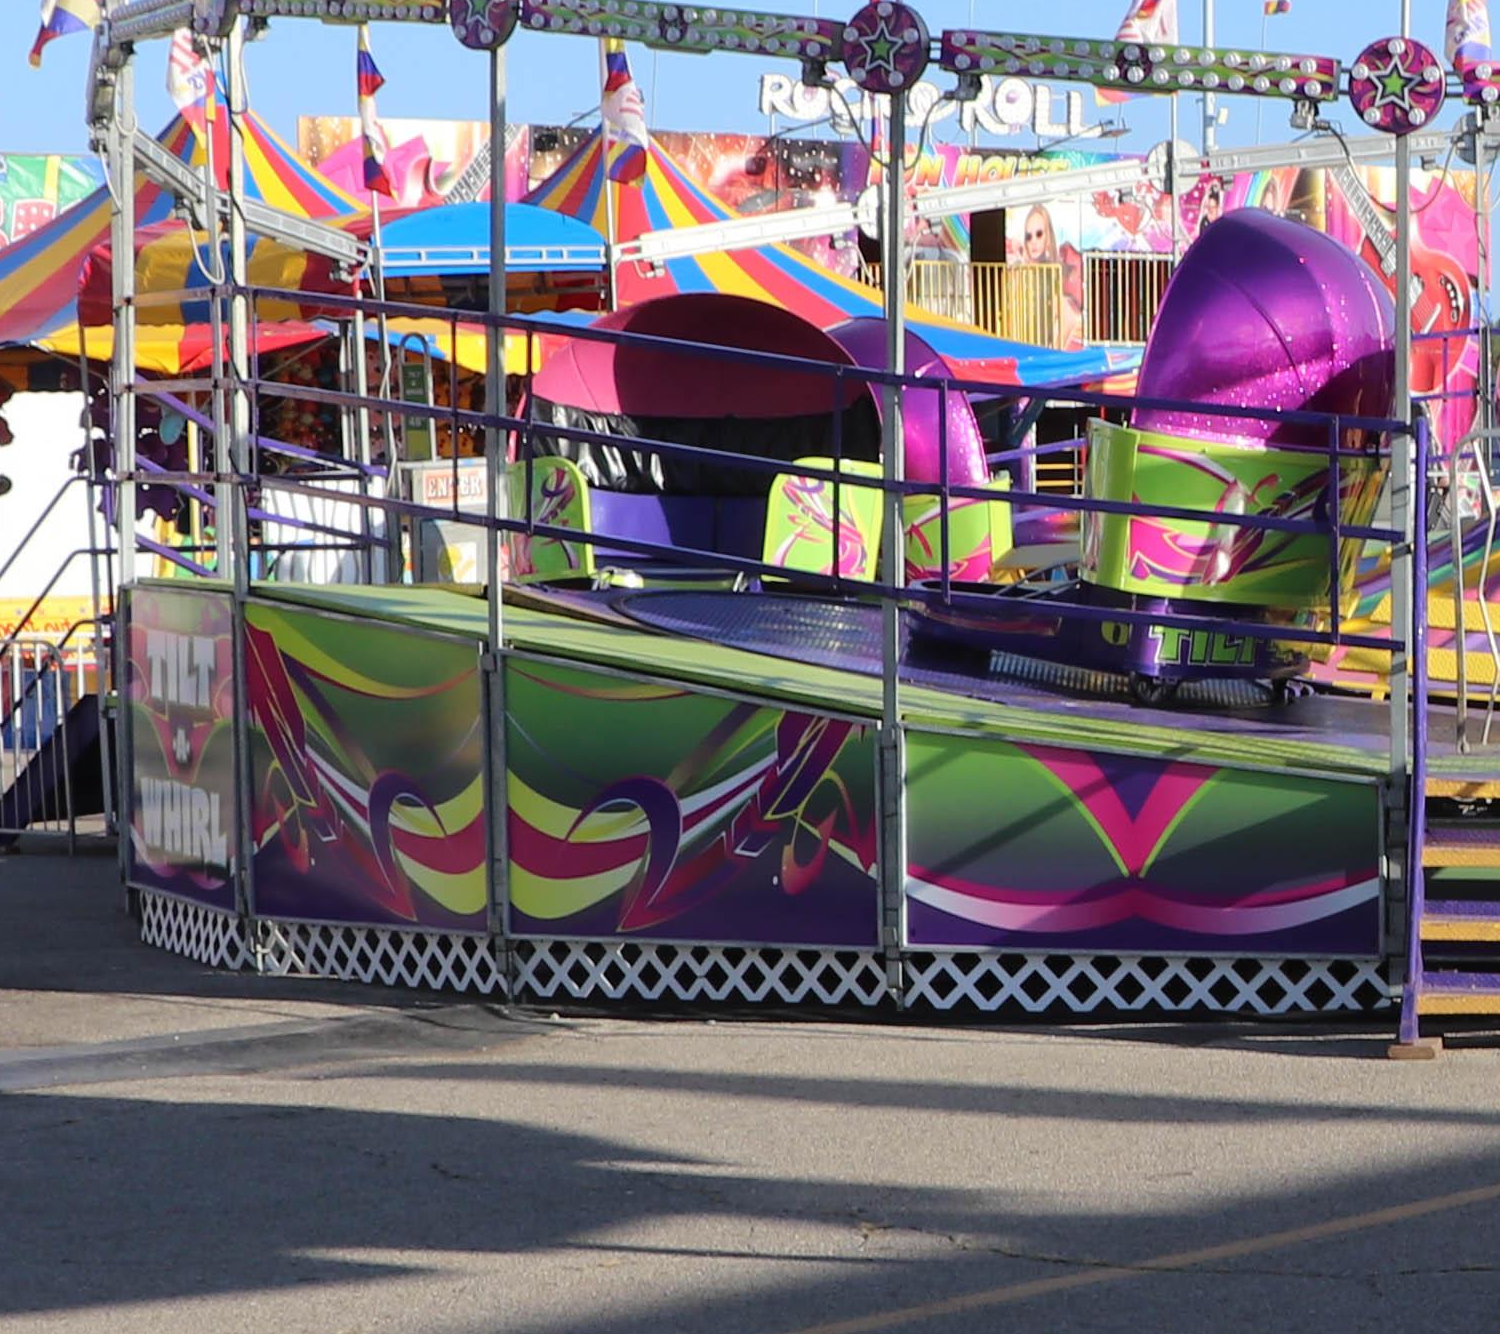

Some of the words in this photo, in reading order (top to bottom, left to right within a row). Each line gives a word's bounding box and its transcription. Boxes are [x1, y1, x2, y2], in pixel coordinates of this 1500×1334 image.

[146, 628, 215, 709] TILT
[173, 726, 190, 765] A
[140, 775, 228, 868] WHIRL
